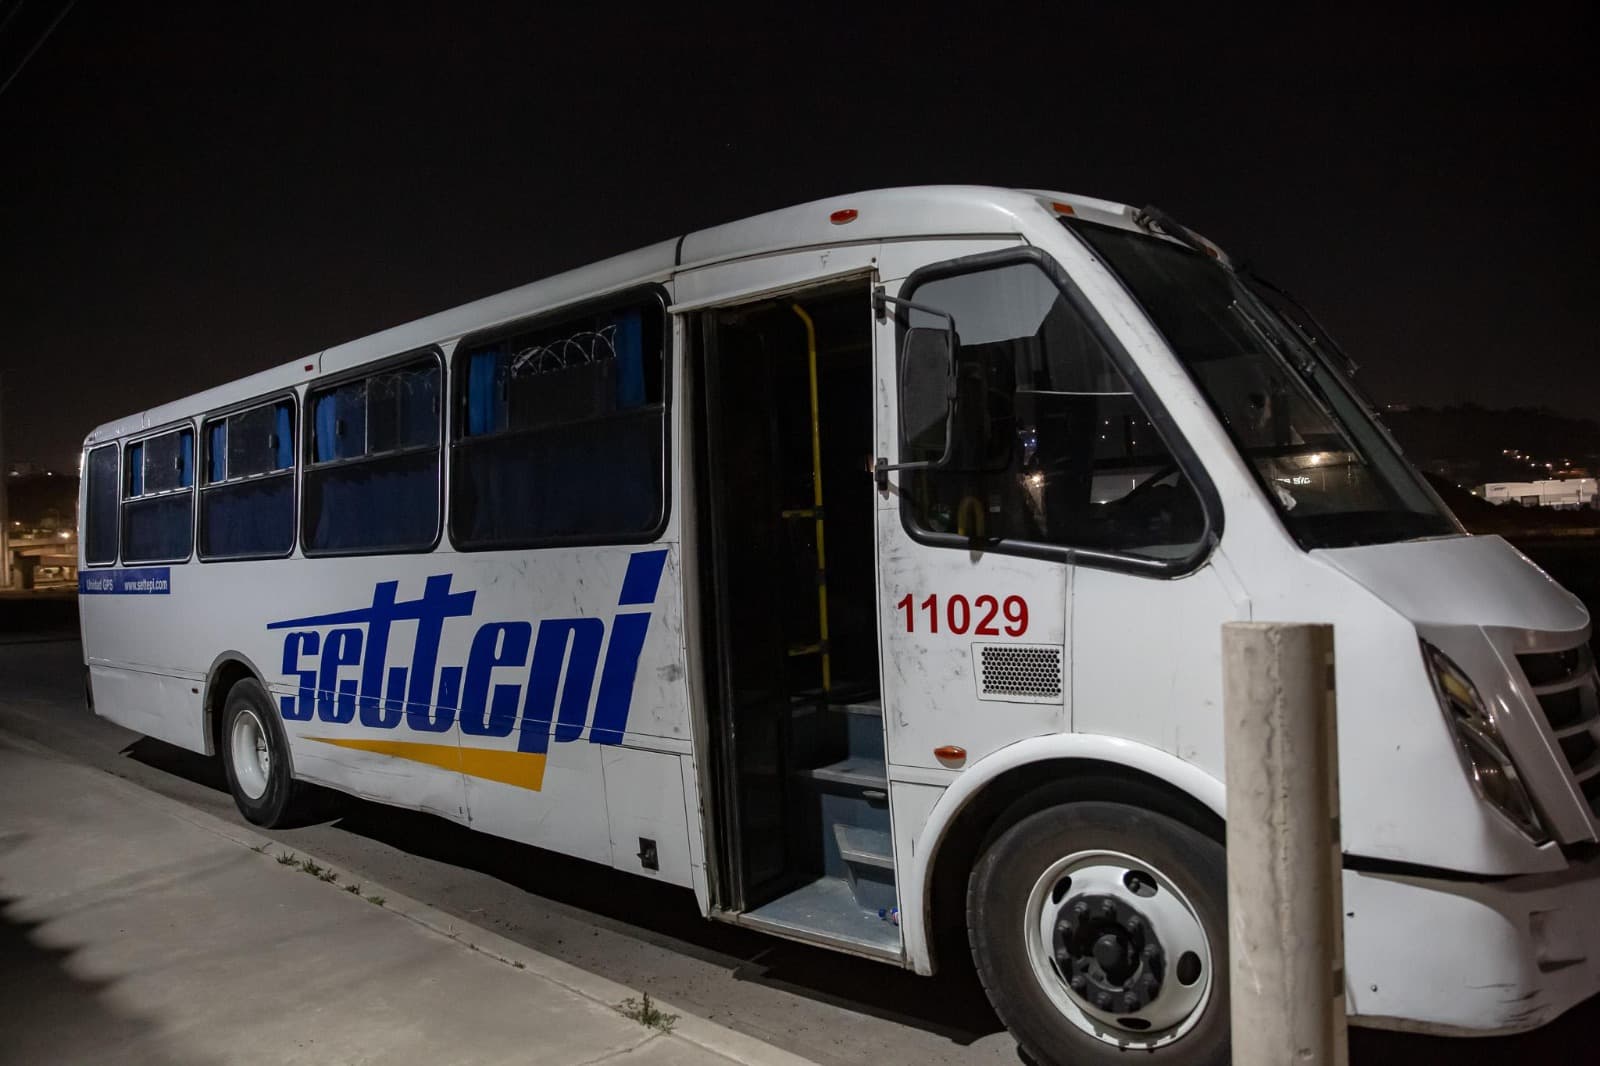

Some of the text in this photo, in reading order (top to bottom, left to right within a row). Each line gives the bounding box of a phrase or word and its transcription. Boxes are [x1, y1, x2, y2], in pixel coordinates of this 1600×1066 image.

[102, 578, 114, 591] GPS
[124, 577, 168, 594] www.settepi.com
[897, 593, 1029, 637] 11029
[267, 549, 668, 754] settepi
